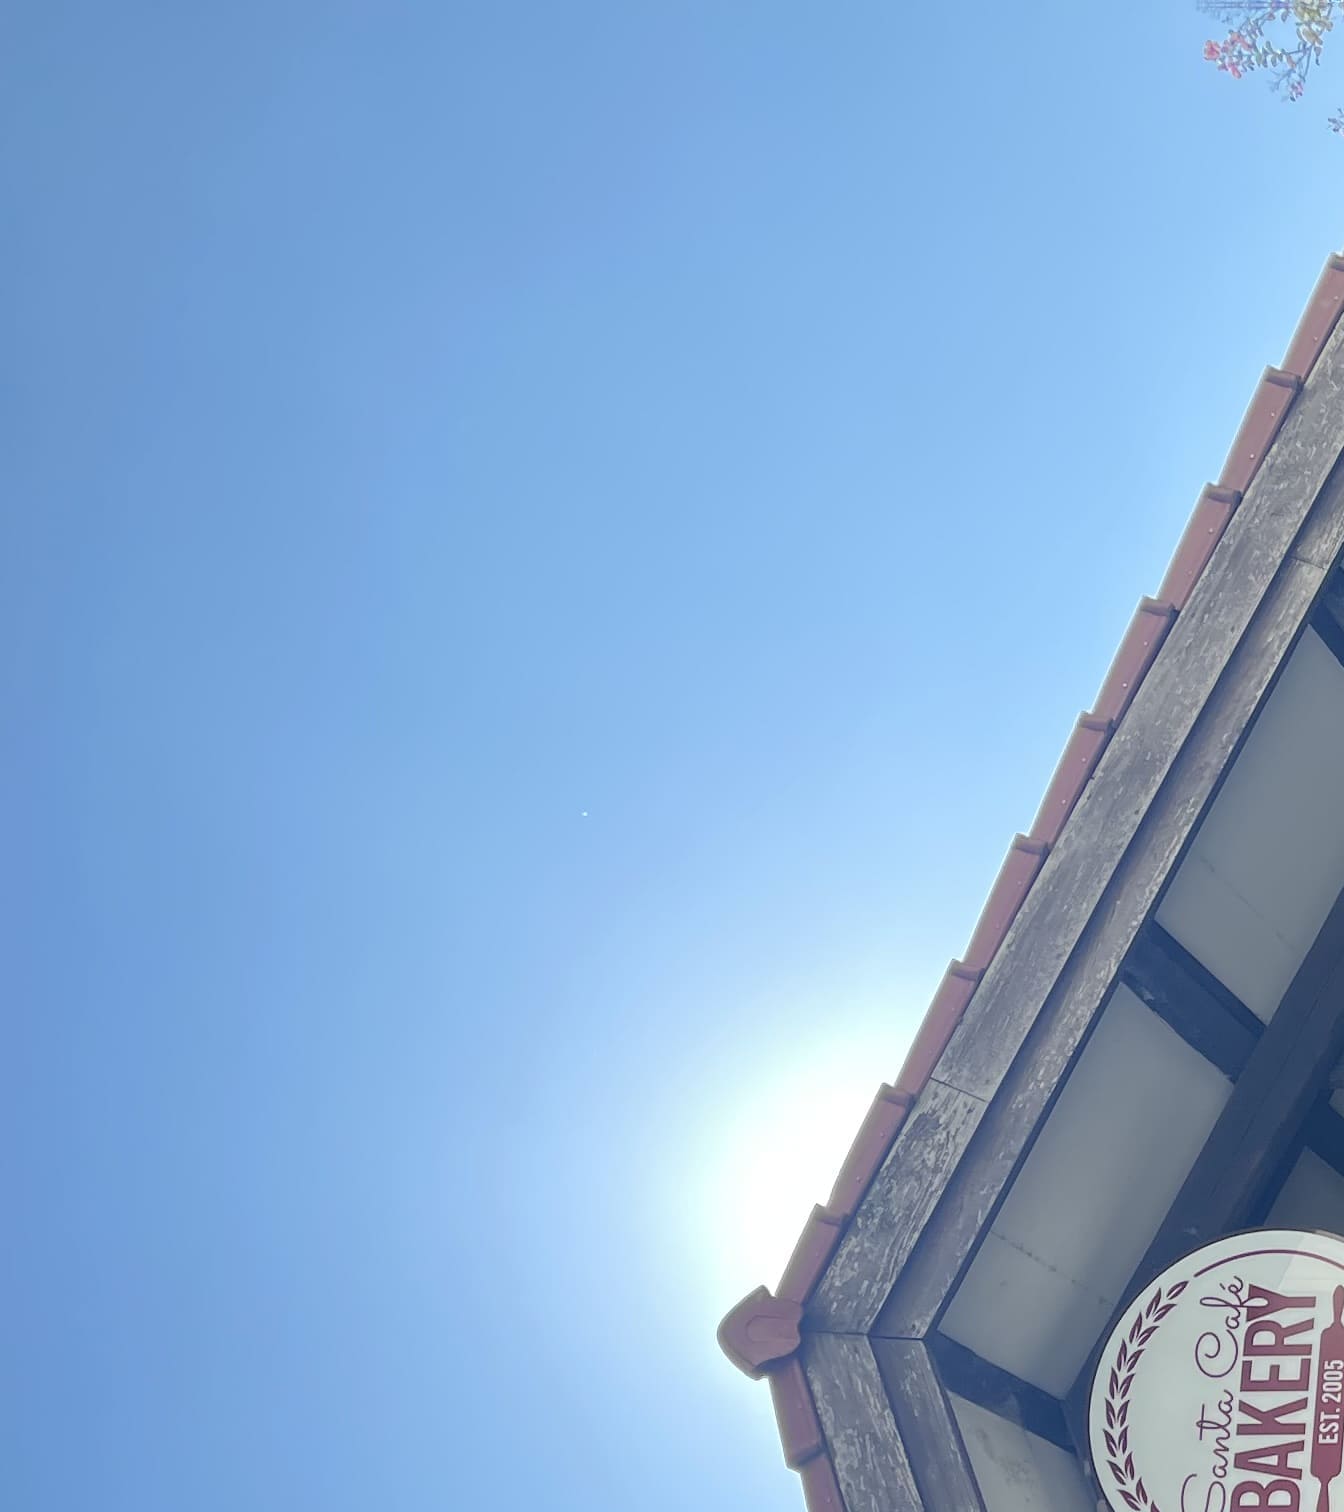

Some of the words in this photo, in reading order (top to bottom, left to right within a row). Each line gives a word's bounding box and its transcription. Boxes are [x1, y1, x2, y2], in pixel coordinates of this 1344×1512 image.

[1194, 1276, 1269, 1378] Café
[1321, 1359, 1344, 1403] 2005
[1317, 1407, 1341, 1445] EST.
